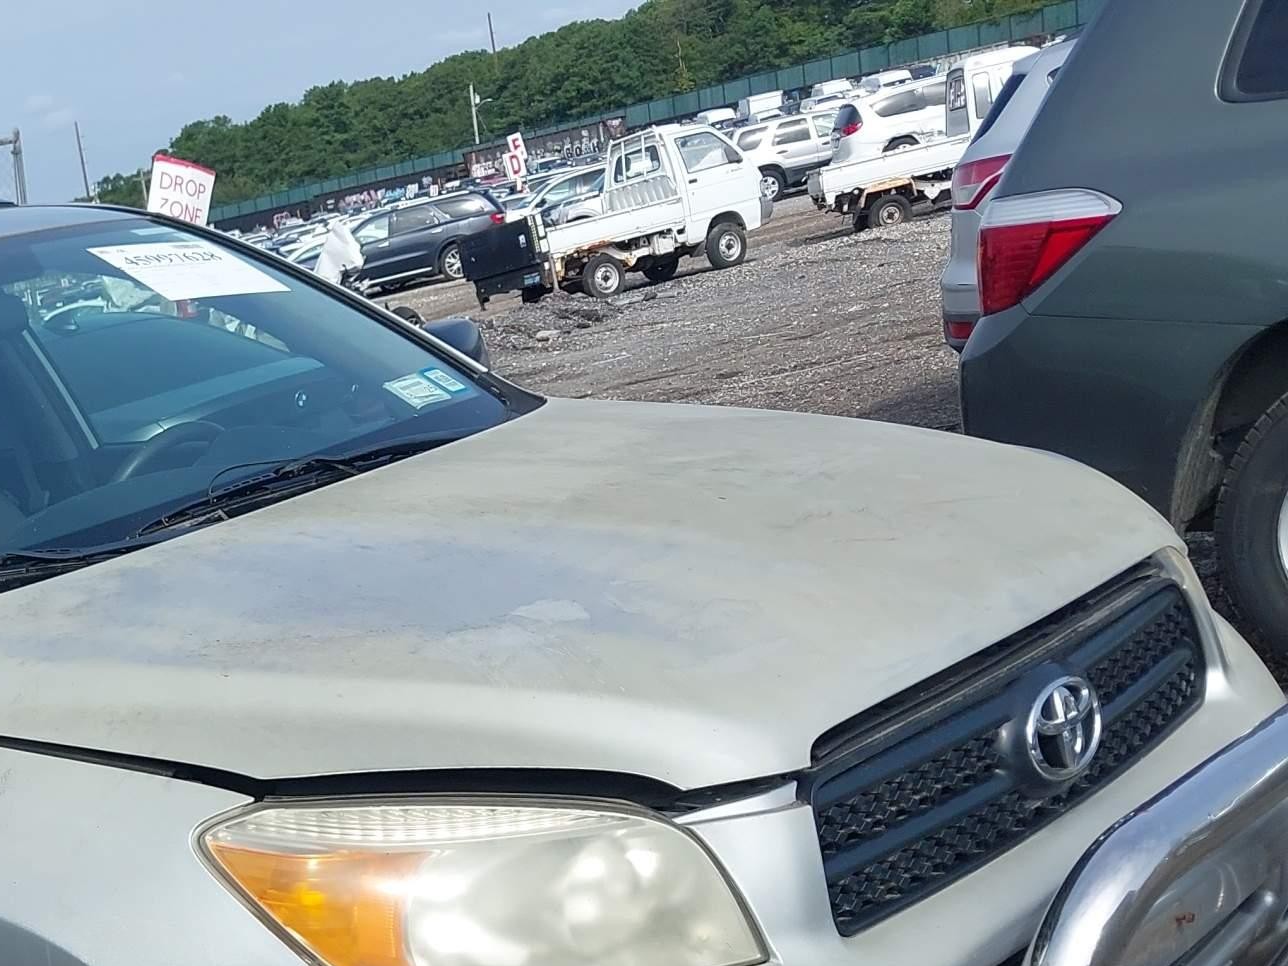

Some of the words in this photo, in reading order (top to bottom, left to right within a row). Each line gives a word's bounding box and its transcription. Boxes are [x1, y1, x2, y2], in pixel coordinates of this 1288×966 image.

[509, 154, 521, 174] D
[160, 171, 206, 200] DROP
[123, 251, 223, 266] 45997628
